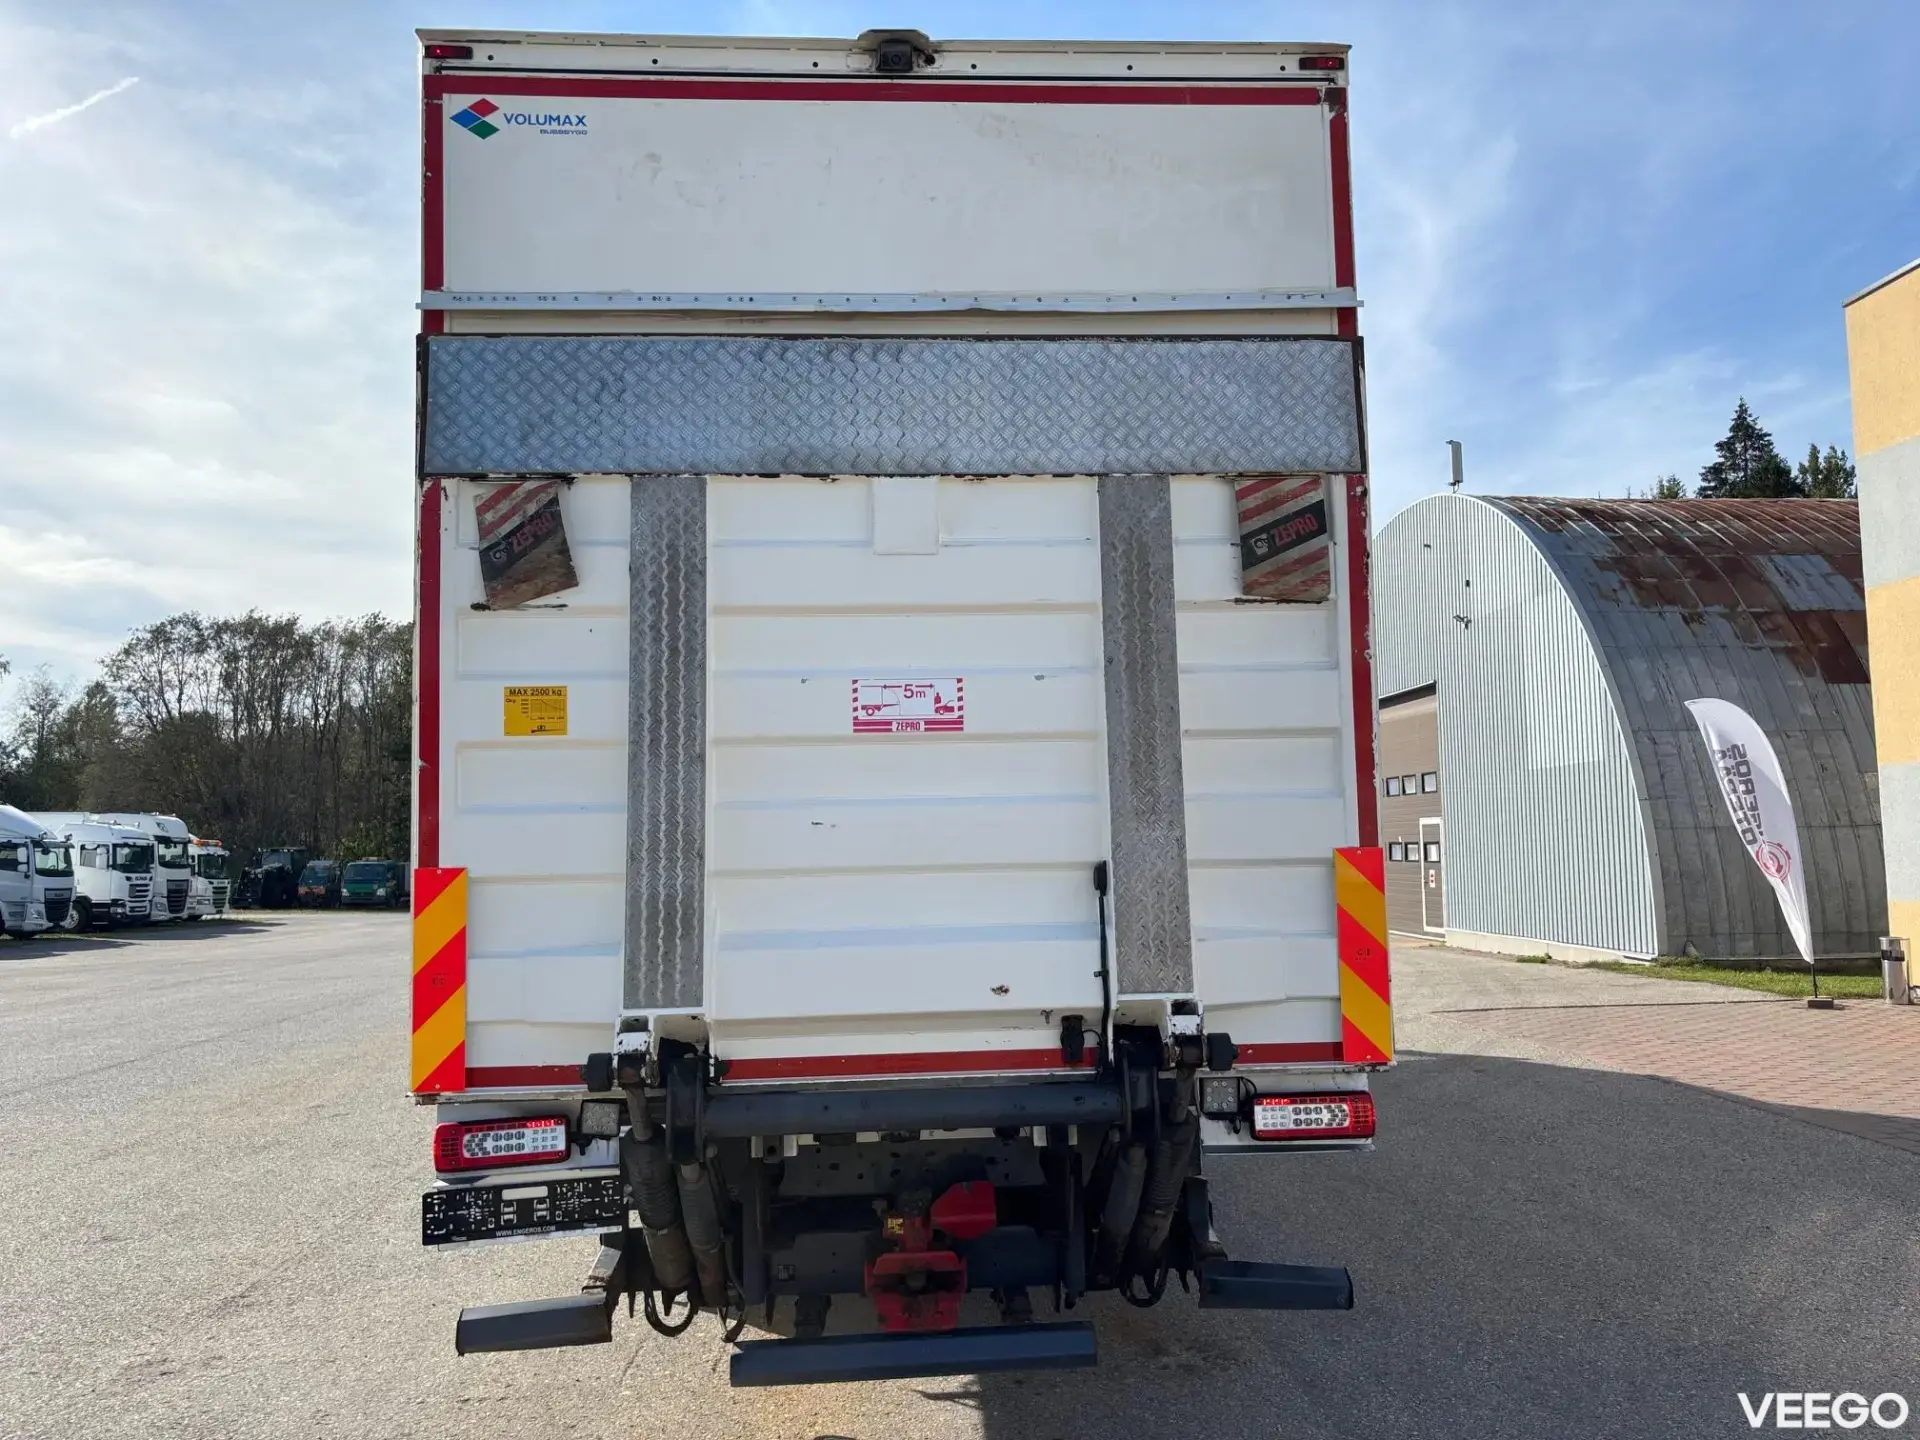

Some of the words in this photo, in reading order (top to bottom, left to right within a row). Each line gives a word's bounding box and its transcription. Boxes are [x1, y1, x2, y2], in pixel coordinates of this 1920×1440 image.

[503, 113, 588, 127] VOLUMAX
[1271, 513, 1319, 547] ZEPRO
[509, 688, 528, 697] MAX
[529, 688, 550, 697] 2500
[551, 688, 562, 697] kg
[895, 721, 921, 732] ZEPRO
